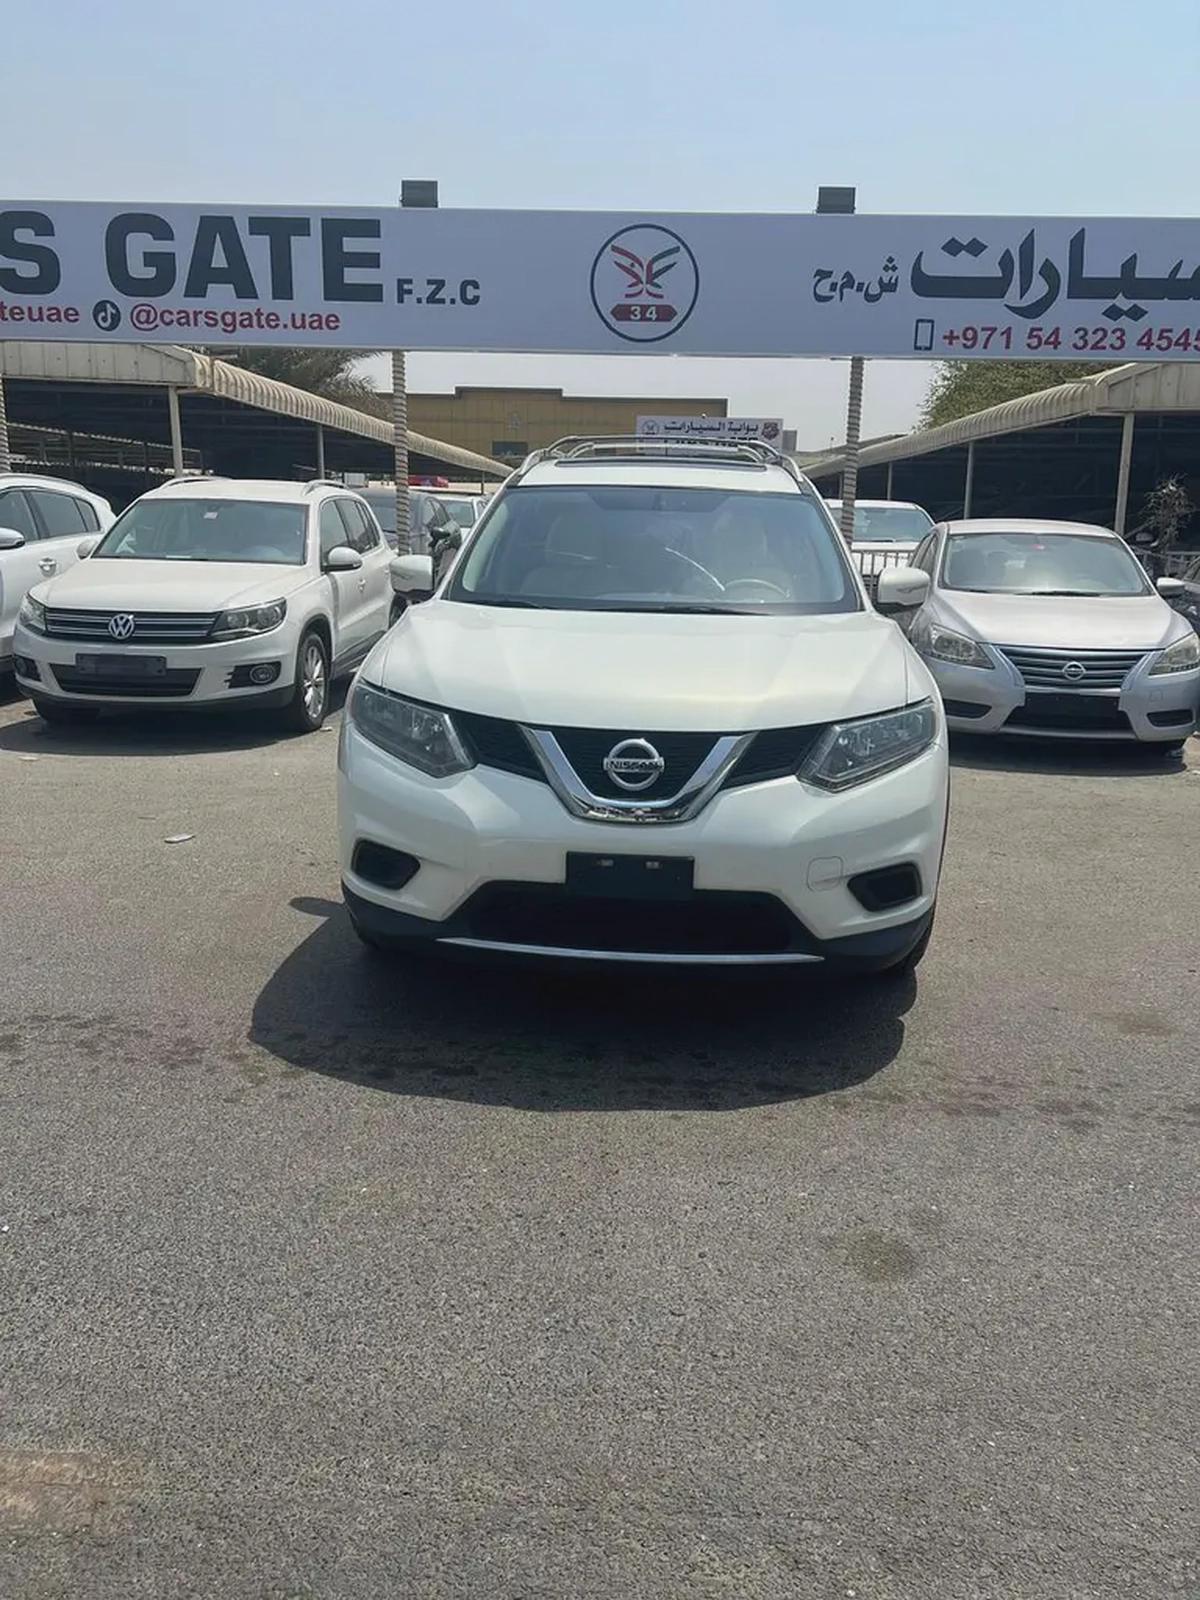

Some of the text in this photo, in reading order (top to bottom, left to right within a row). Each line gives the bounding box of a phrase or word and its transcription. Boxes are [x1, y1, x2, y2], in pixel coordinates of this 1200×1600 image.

[0, 210, 481, 306] S GATE F.Z.C
[130, 303, 341, 334] @carsgate.uae
[943, 325, 1012, 350] +971
[1026, 326, 1062, 350] 54
[1071, 326, 1127, 351] 323
